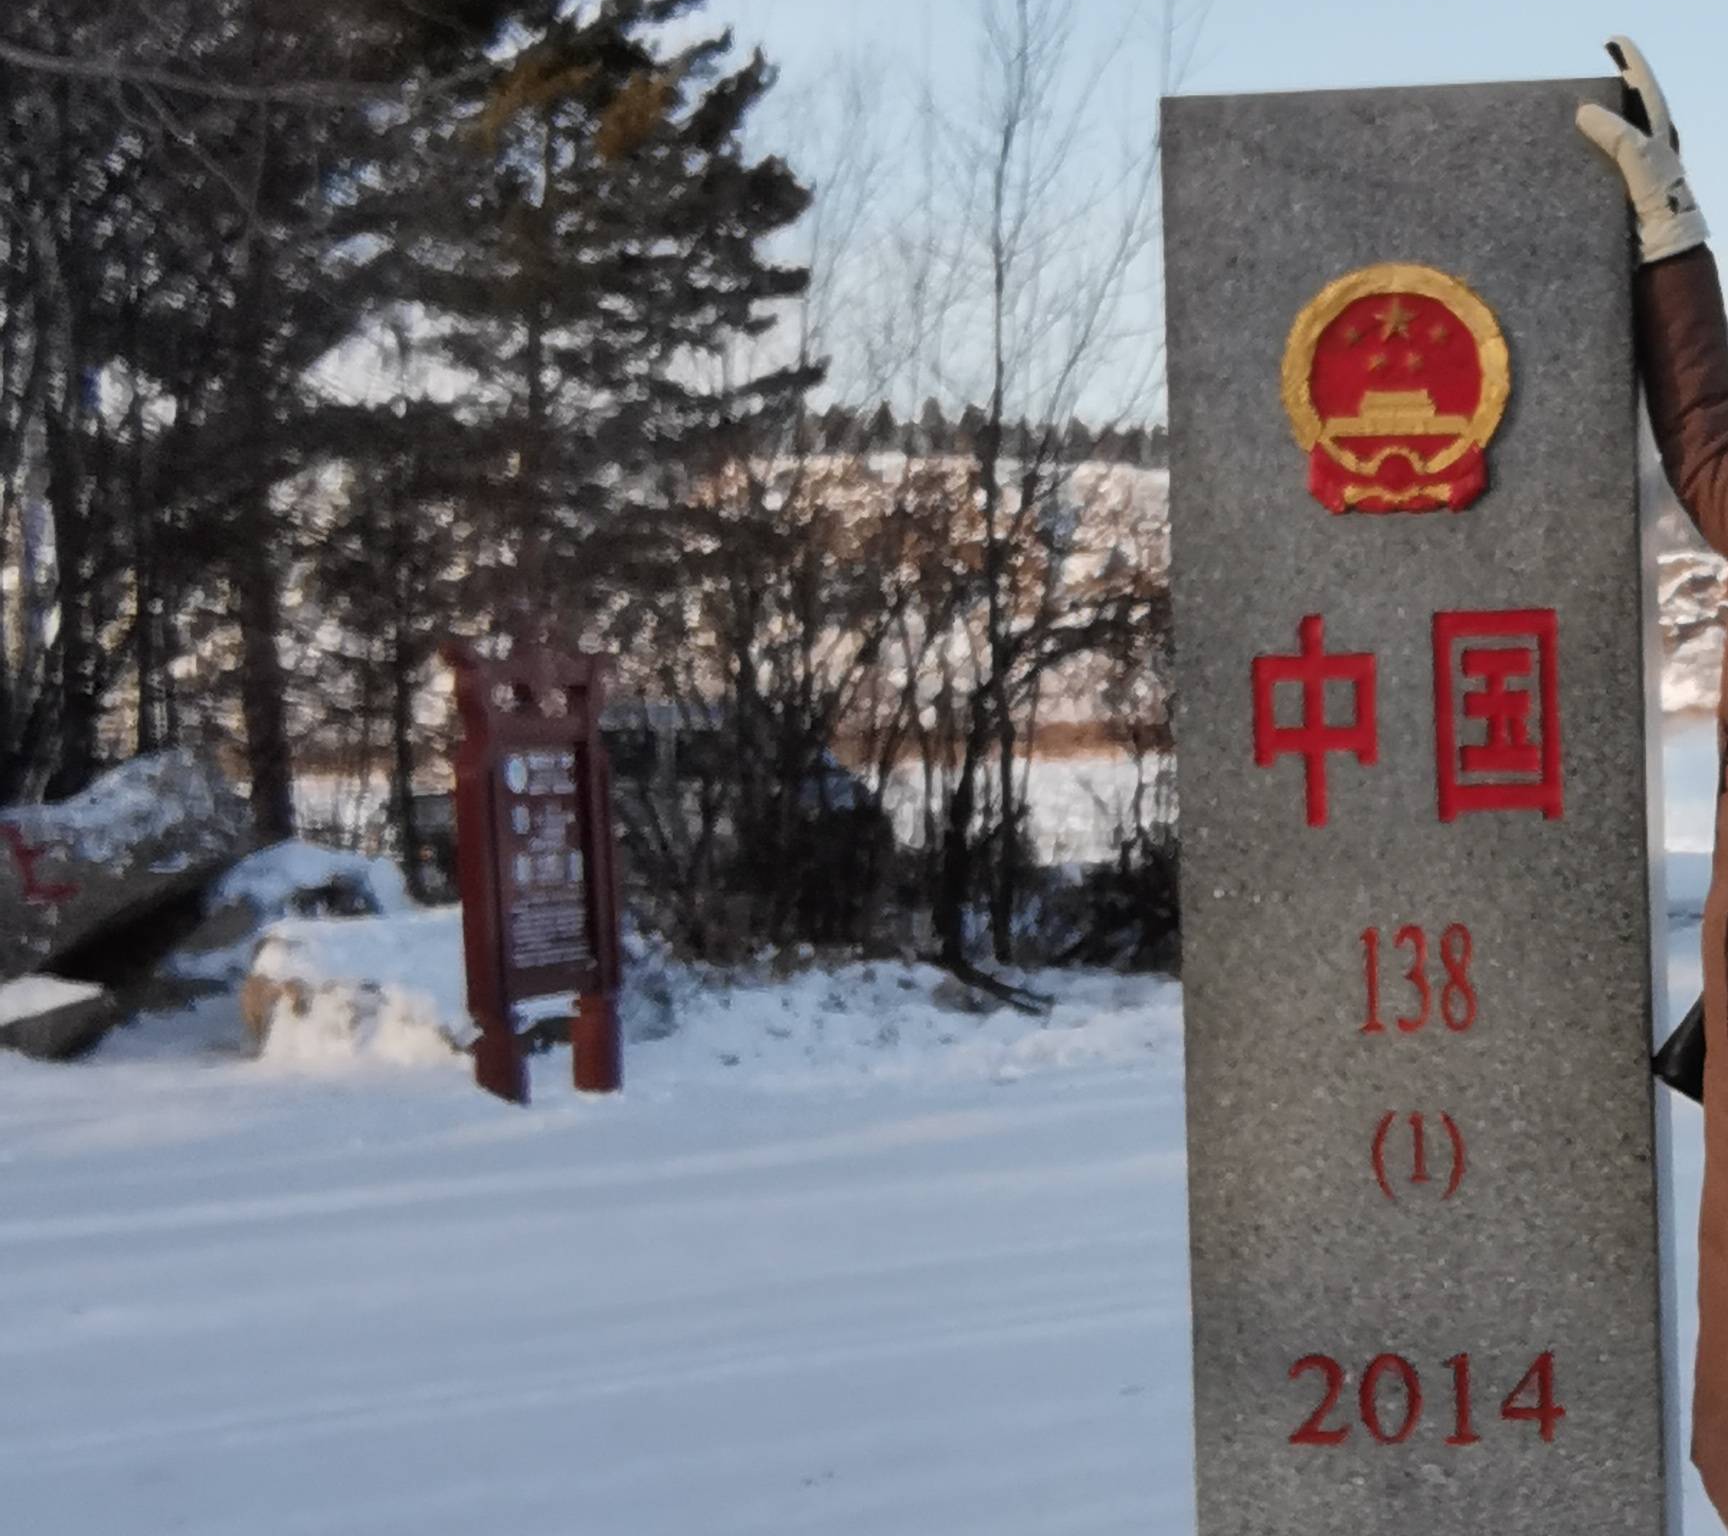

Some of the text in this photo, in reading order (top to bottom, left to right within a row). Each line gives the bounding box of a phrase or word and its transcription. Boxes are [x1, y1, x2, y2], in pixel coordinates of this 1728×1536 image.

[1250, 607, 1565, 830] 中国
[1359, 923, 1479, 1036] 138
[1370, 1111, 1467, 1198] (1)
[1287, 1351, 1567, 1447] 2014
